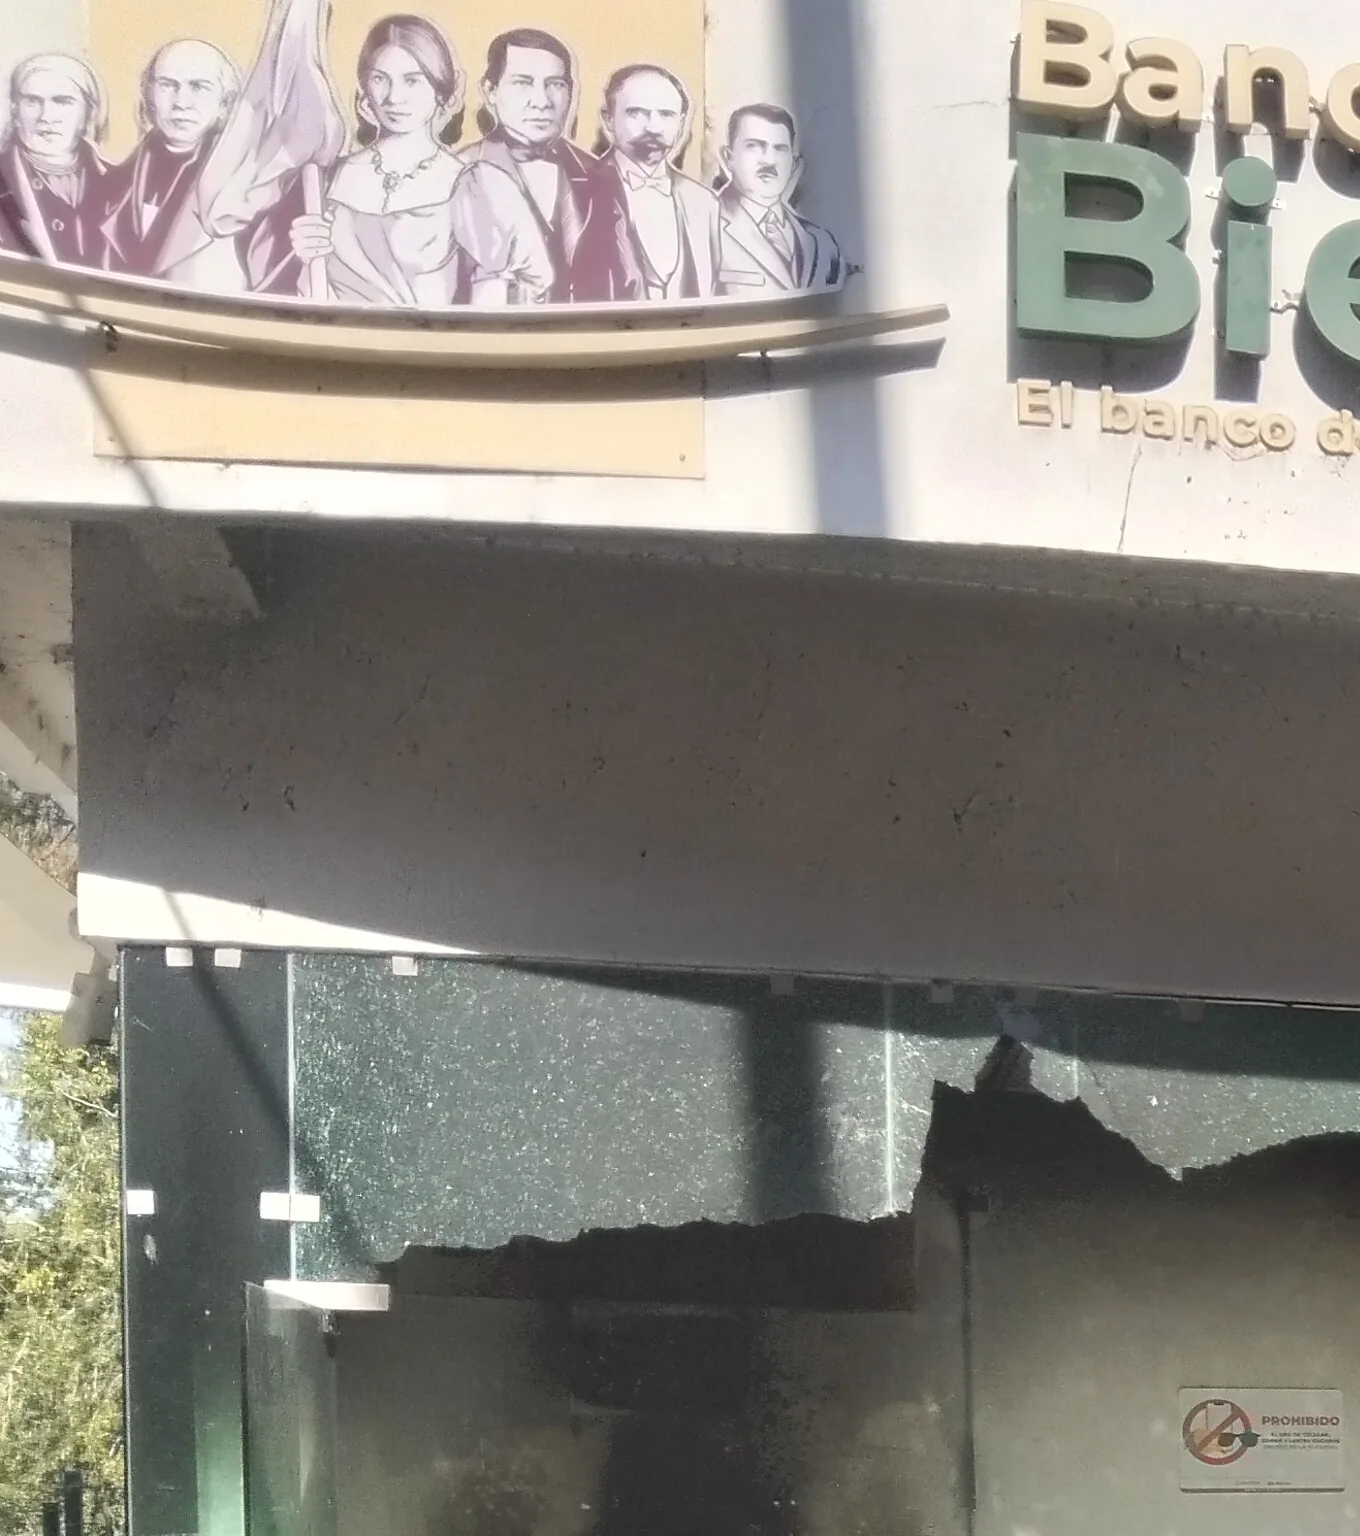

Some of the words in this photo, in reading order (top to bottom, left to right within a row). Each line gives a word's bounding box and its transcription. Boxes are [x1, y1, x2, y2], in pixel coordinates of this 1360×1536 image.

[1016, 378, 1073, 429] El
[1099, 385, 1296, 451] banco
[1261, 1415, 1340, 1426] PROHIBIDO
